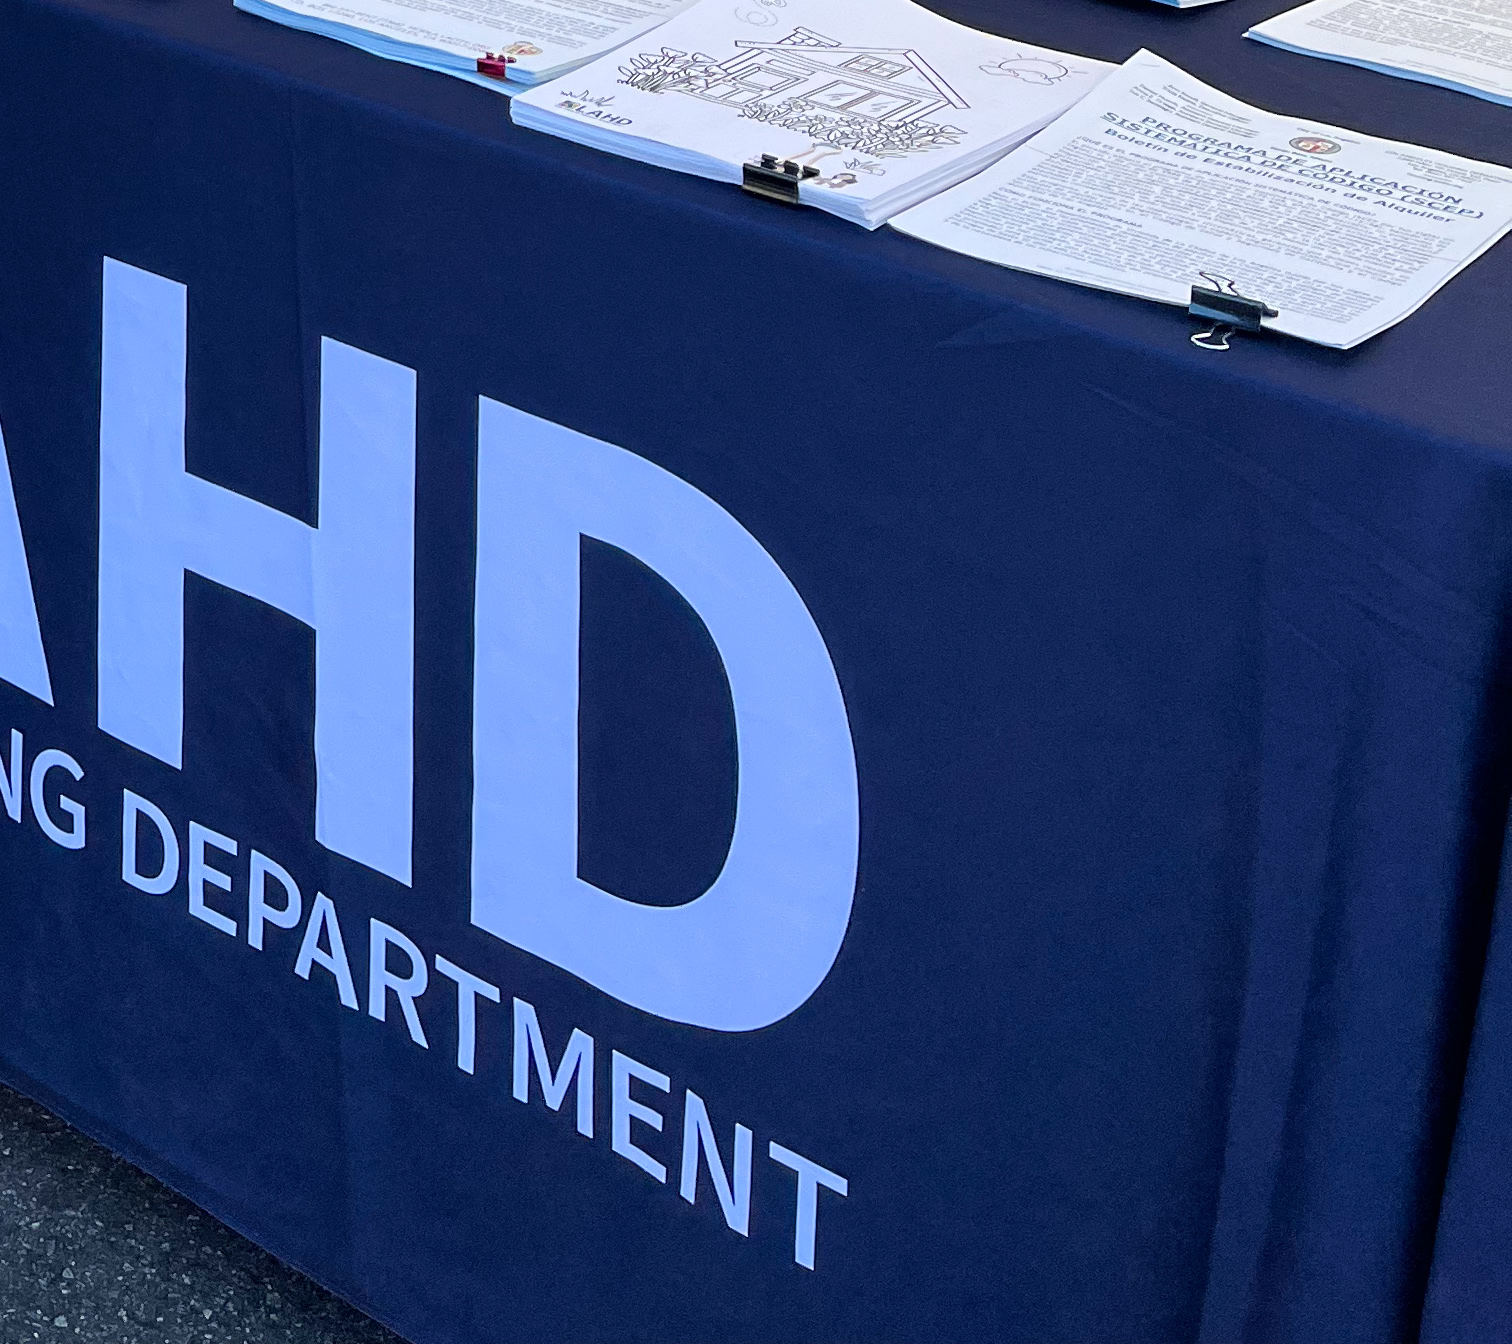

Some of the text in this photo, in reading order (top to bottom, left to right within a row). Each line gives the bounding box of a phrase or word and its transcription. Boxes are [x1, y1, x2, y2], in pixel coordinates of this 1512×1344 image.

[575, 105, 633, 125] LAHD
[1141, 115, 1268, 158] PROGRAMA
[1275, 154, 1308, 169] DE
[1309, 163, 1464, 205] APLICACIÓN
[1103, 127, 1455, 224] Boletín de Estabilización de Alquiler
[1255, 158, 1291, 173] DE
[1297, 165, 1395, 197] CÓDIGO
[1399, 192, 1484, 220] (SCEP)
[120, 786, 849, 1270] DEPARTMENT
